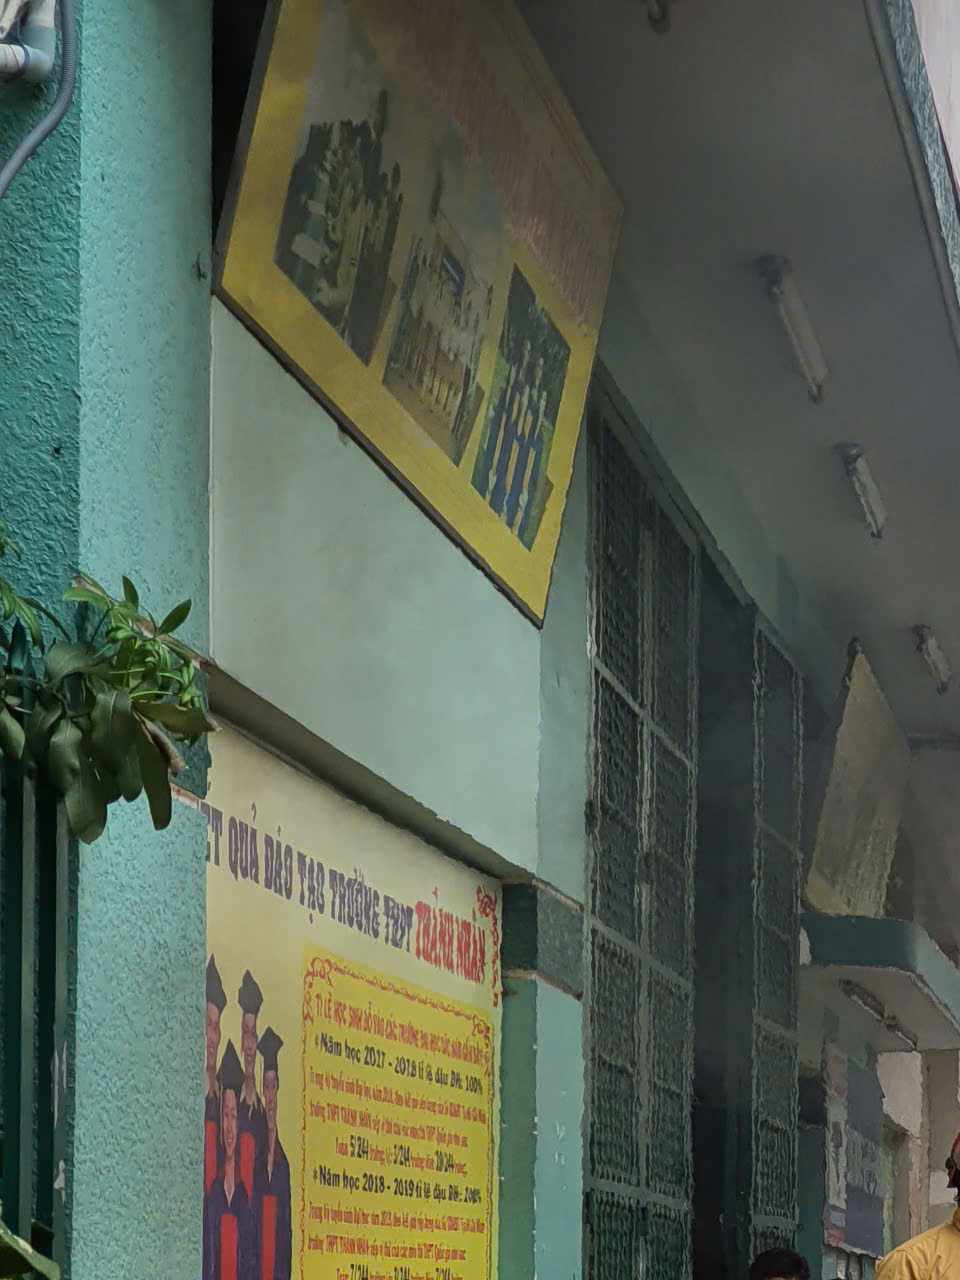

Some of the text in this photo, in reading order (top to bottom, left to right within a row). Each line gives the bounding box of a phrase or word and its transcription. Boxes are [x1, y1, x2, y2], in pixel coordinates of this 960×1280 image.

[228, 802, 260, 885] QUẢ
[345, 1038, 361, 1064] học
[319, 1165, 341, 1188] Năm
[342, 1169, 360, 1194] học
[362, 1172, 385, 1193] 2018
[394, 1177, 415, 1197] 2019
